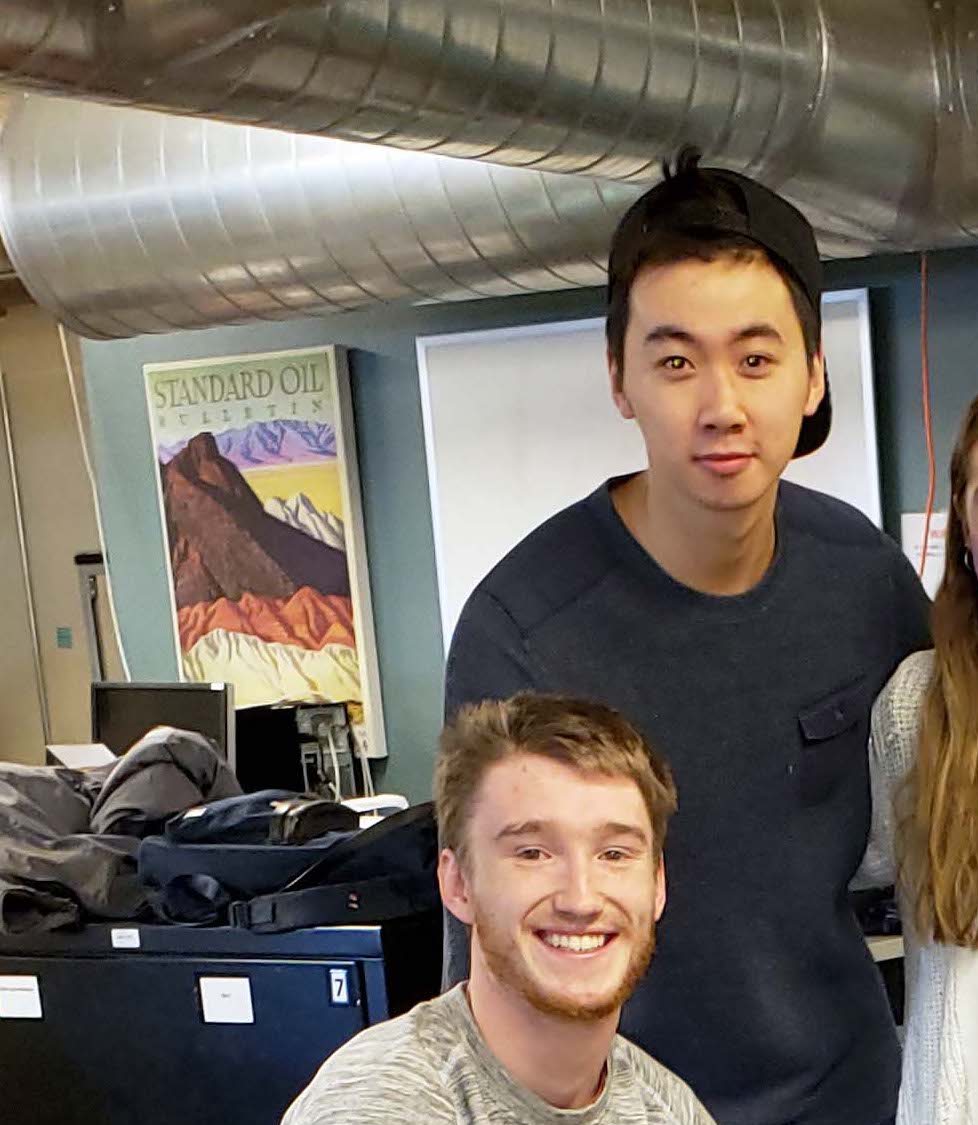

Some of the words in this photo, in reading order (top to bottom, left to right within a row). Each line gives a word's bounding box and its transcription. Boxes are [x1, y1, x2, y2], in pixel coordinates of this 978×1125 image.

[154, 368, 274, 409] STANDARD
[280, 362, 324, 395] OIL
[334, 978, 344, 997] 7
